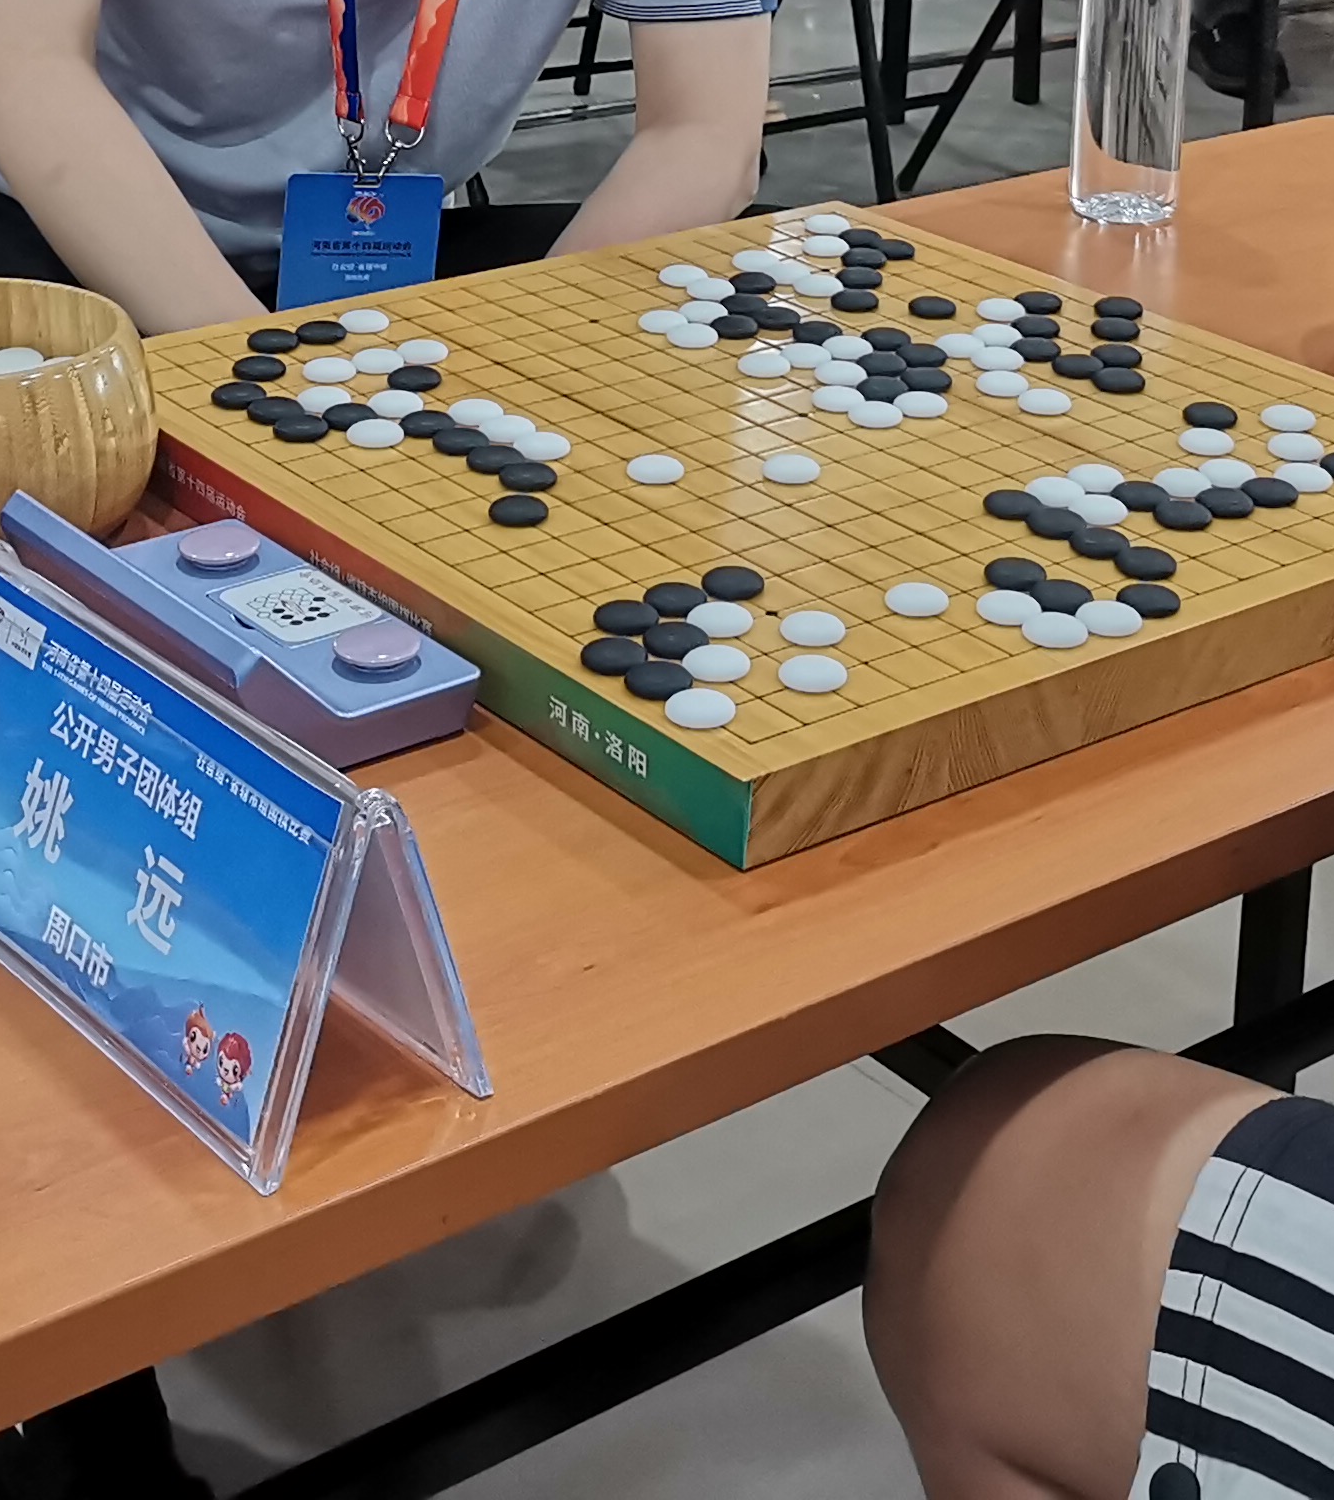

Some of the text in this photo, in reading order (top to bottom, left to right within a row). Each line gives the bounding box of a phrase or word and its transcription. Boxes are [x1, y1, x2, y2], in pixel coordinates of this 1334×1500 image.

[42, 639, 154, 725] 河南省第十四届运动会
[49, 700, 204, 841] 公开男子团体组
[548, 694, 648, 779] 河南·洛阳
[42, 904, 114, 987] 周口市
